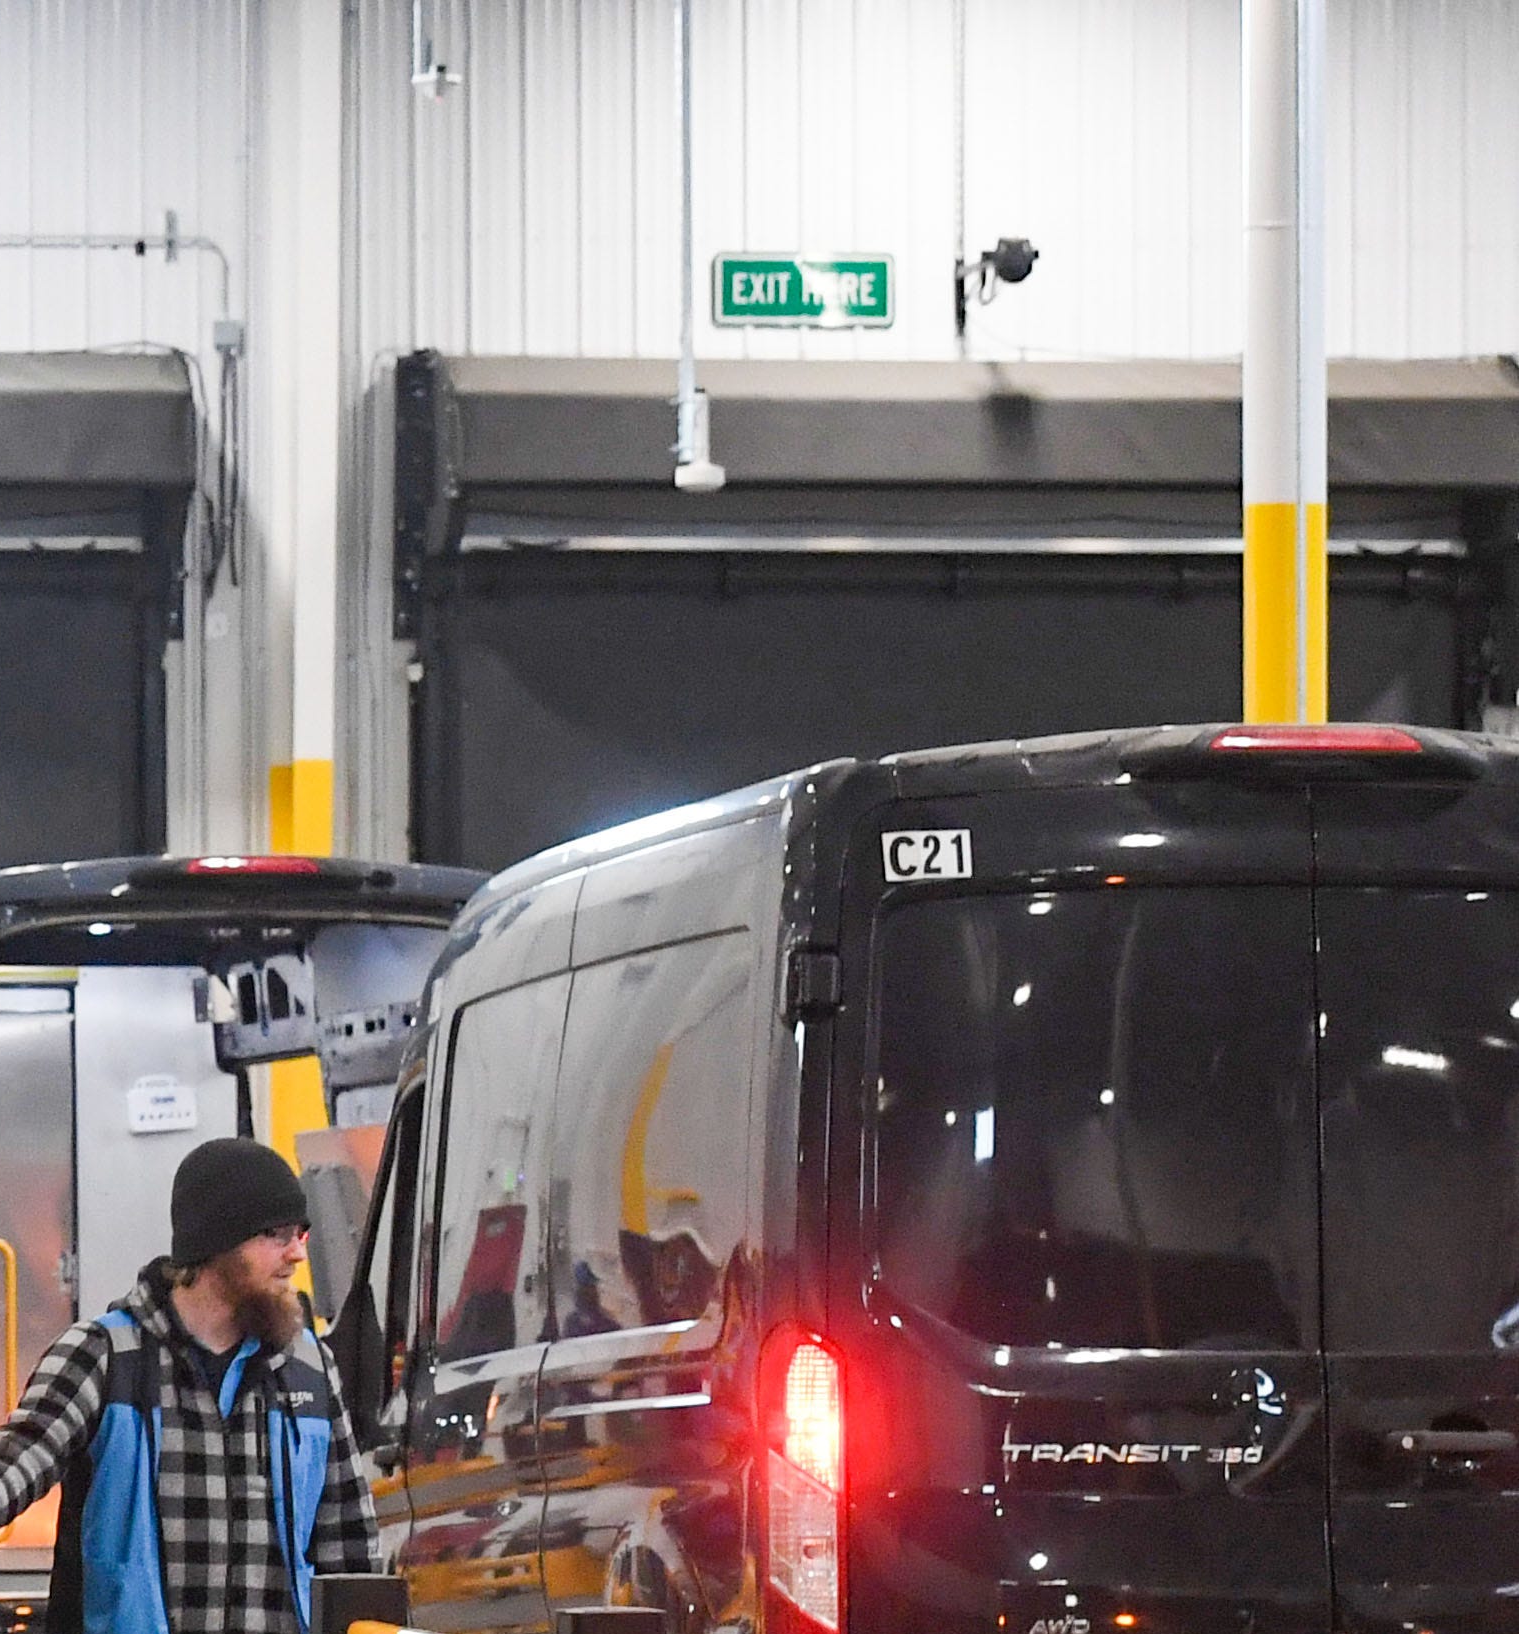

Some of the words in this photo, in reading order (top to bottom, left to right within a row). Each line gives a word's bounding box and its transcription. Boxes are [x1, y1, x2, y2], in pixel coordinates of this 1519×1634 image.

[731, 272, 791, 305] EXIT
[889, 834, 965, 876] C21
[1001, 1443, 1201, 1464] TRANSIT
[1206, 1444, 1264, 1464] 350
